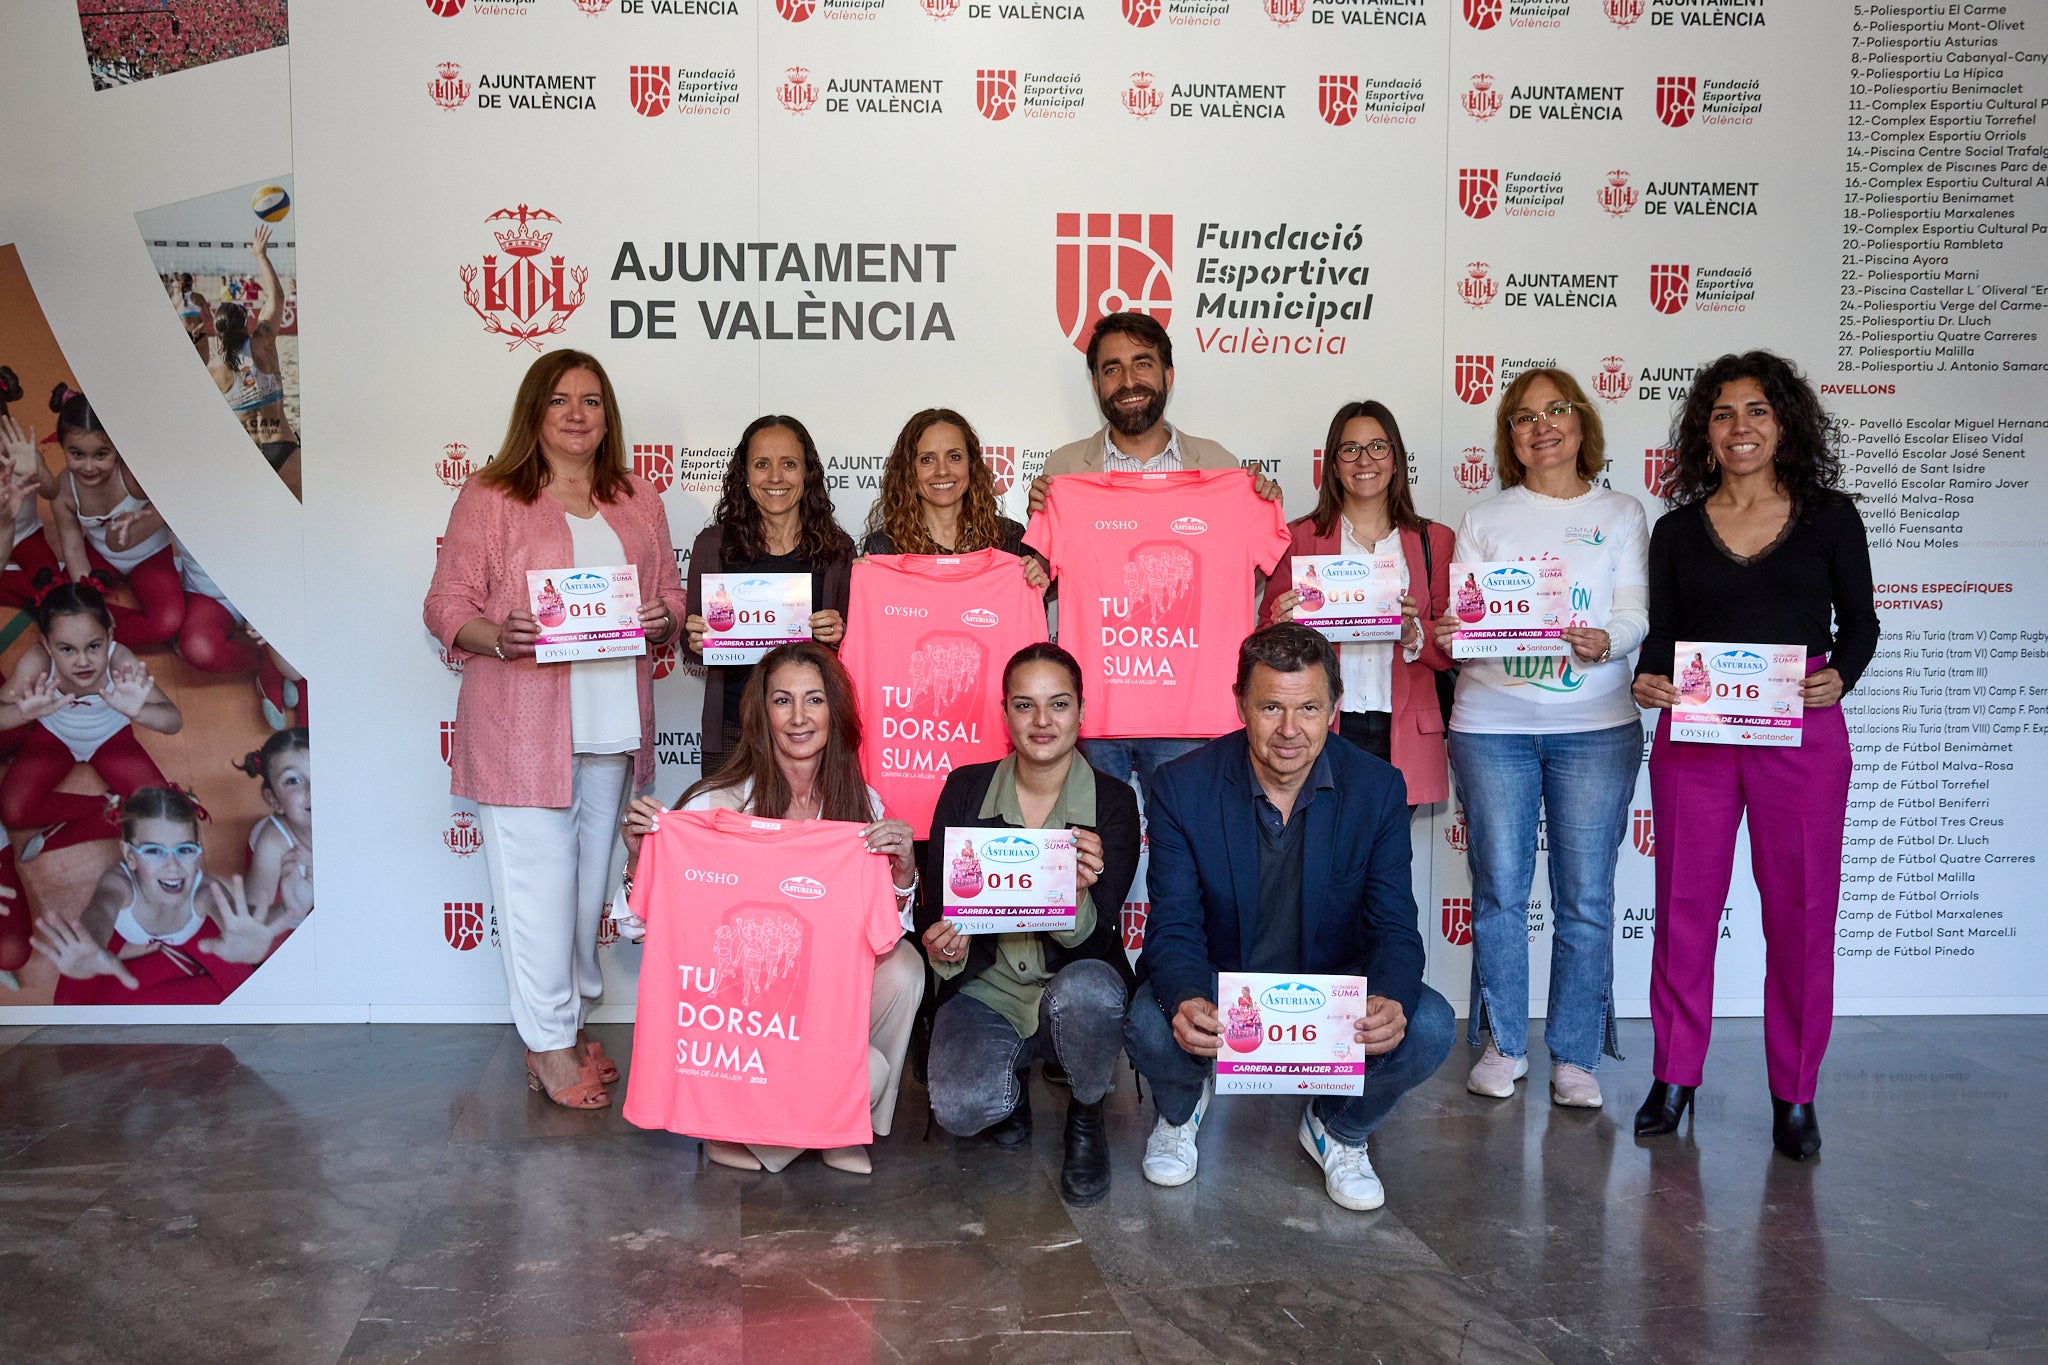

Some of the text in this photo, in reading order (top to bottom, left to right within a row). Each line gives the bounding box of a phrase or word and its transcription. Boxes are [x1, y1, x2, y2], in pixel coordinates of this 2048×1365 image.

[1854, 4, 2006, 17] 5.-Poliesportiu El Carme
[1853, 20, 2025, 33] 6.-Poliesportiu Mont-Olivet
[678, 69, 735, 79] Fundació
[1851, 68, 1940, 81] 9.-Poliesportiu
[1944, 68, 1959, 78] La
[478, 75, 596, 89] AJUNTAMENT
[678, 81, 738, 92] Esportiva
[827, 79, 943, 93] AJUNTAMENT
[1366, 79, 1422, 88] Fundació
[1366, 91, 1424, 101] Esportiva
[1511, 86, 1624, 100] AJUNTAMENT
[1850, 83, 2023, 96] 10.-Poliesportiu Benimaclet
[478, 92, 596, 109] DE VALÈNCIA
[678, 93, 739, 105] Municipal
[826, 96, 943, 113] DE VALÈNCIA
[678, 105, 730, 115] València
[1365, 102, 1425, 114] Municipal
[1510, 103, 1623, 120] DE VALÈNCIA
[1365, 114, 1416, 124] València
[1848, 114, 2036, 127] 12.-Complex Esportiu Torrefiel
[1848, 130, 2026, 143] 13.-Complex Esportiu Orriols
[1505, 172, 1561, 182] Fundació
[1505, 184, 1563, 194] Esportiva
[1646, 182, 1759, 196] AJUNTAMENT
[1505, 195, 1564, 207] Municipal
[1845, 193, 2014, 206] 17.-Poliesportiu Benimamet
[1504, 207, 1555, 217] València
[1645, 199, 1757, 215] DE VALÈNCIA
[1197, 223, 1362, 250] Fundació
[611, 242, 956, 284] AJUNTAMENT
[1842, 254, 1948, 267] 21.-Piscina Ayora
[1196, 258, 1369, 291] Esportiva
[1506, 274, 1618, 288] AJUNTAMENT
[1842, 270, 1863, 280] 22.-
[1868, 269, 1941, 283] Poliesportiu
[1505, 290, 1617, 308] DE VALÈNCIA
[1196, 292, 1373, 327] Municipal
[611, 291, 956, 342] DE VALÈNCIA
[1840, 315, 1991, 328] 25.-Poliesportiu Dr. Lluch
[1196, 327, 1346, 354] València
[1839, 331, 2037, 344] 26.-Poliesportiu Quatre Carreres
[1859, 346, 1931, 359] Poliesportiu
[1935, 346, 1974, 356] Malilla
[1820, 384, 1896, 394] PAVELLONS
[1905, 433, 1949, 443] Escolar
[1953, 433, 1988, 443] Eliseo
[1902, 463, 1916, 473] de
[1920, 464, 1949, 473] Sant
[1953, 463, 1985, 473] Isidre
[1095, 520, 1138, 530] OYSHO
[564, 582, 606, 591] ASTURIANA
[1487, 578, 1531, 586] ASTURIANA
[1922, 581, 2013, 594] ESPECÍFIQUES
[1328, 589, 1365, 602] 016
[570, 602, 606, 617] 016
[885, 606, 928, 618] OYSHO
[1099, 597, 1128, 618] TU
[1490, 600, 1530, 614] 016
[739, 610, 776, 623] 016
[1102, 626, 1198, 648] DORSAL
[545, 649, 580, 658] OYSHO
[606, 644, 640, 652] Santander
[1104, 656, 1174, 677] SUMA
[1715, 658, 1763, 670] ASTURIANA
[1906, 667, 1988, 678] Riu Turia (tram III)
[882, 686, 911, 708] TU
[1716, 683, 1760, 698] 016
[1685, 714, 1721, 722] CARRERA
[1744, 718, 1770, 726] MUJER
[883, 717, 980, 743] DORSAL
[1680, 728, 1720, 738] OYSHO
[1752, 733, 1794, 741] Santander
[882, 748, 952, 772] SUMA
[1844, 816, 2004, 829] Camp de Fútbol Tres Creus
[985, 846, 1035, 857] ASTURIANA
[685, 869, 738, 885] OYSHO
[987, 873, 1032, 888] 016
[1839, 908, 2003, 921] Camp de Fútbol Marxalenes
[1878, 928, 1892, 938] de
[1937, 928, 1964, 937] Sant
[1876, 945, 1890, 958] de
[1894, 945, 1931, 956] Fútbol
[1935, 946, 1974, 955] Pinedo
[678, 965, 715, 992] TU
[1332, 989, 1360, 997] SUMA
[1266, 994, 1321, 1006] ASTURIANA
[678, 1001, 800, 1041] DORSAL
[1268, 1024, 1317, 1042] 016
[677, 1038, 764, 1074] SUMA
[1232, 1064, 1272, 1073] CARRERA
[1274, 1065, 1288, 1073] DE
[1302, 1066, 1331, 1074] MUJER
[1334, 1066, 1353, 1074] 2023
[1228, 1080, 1272, 1090] OYSHO
[1310, 1081, 1356, 1090] Santander
